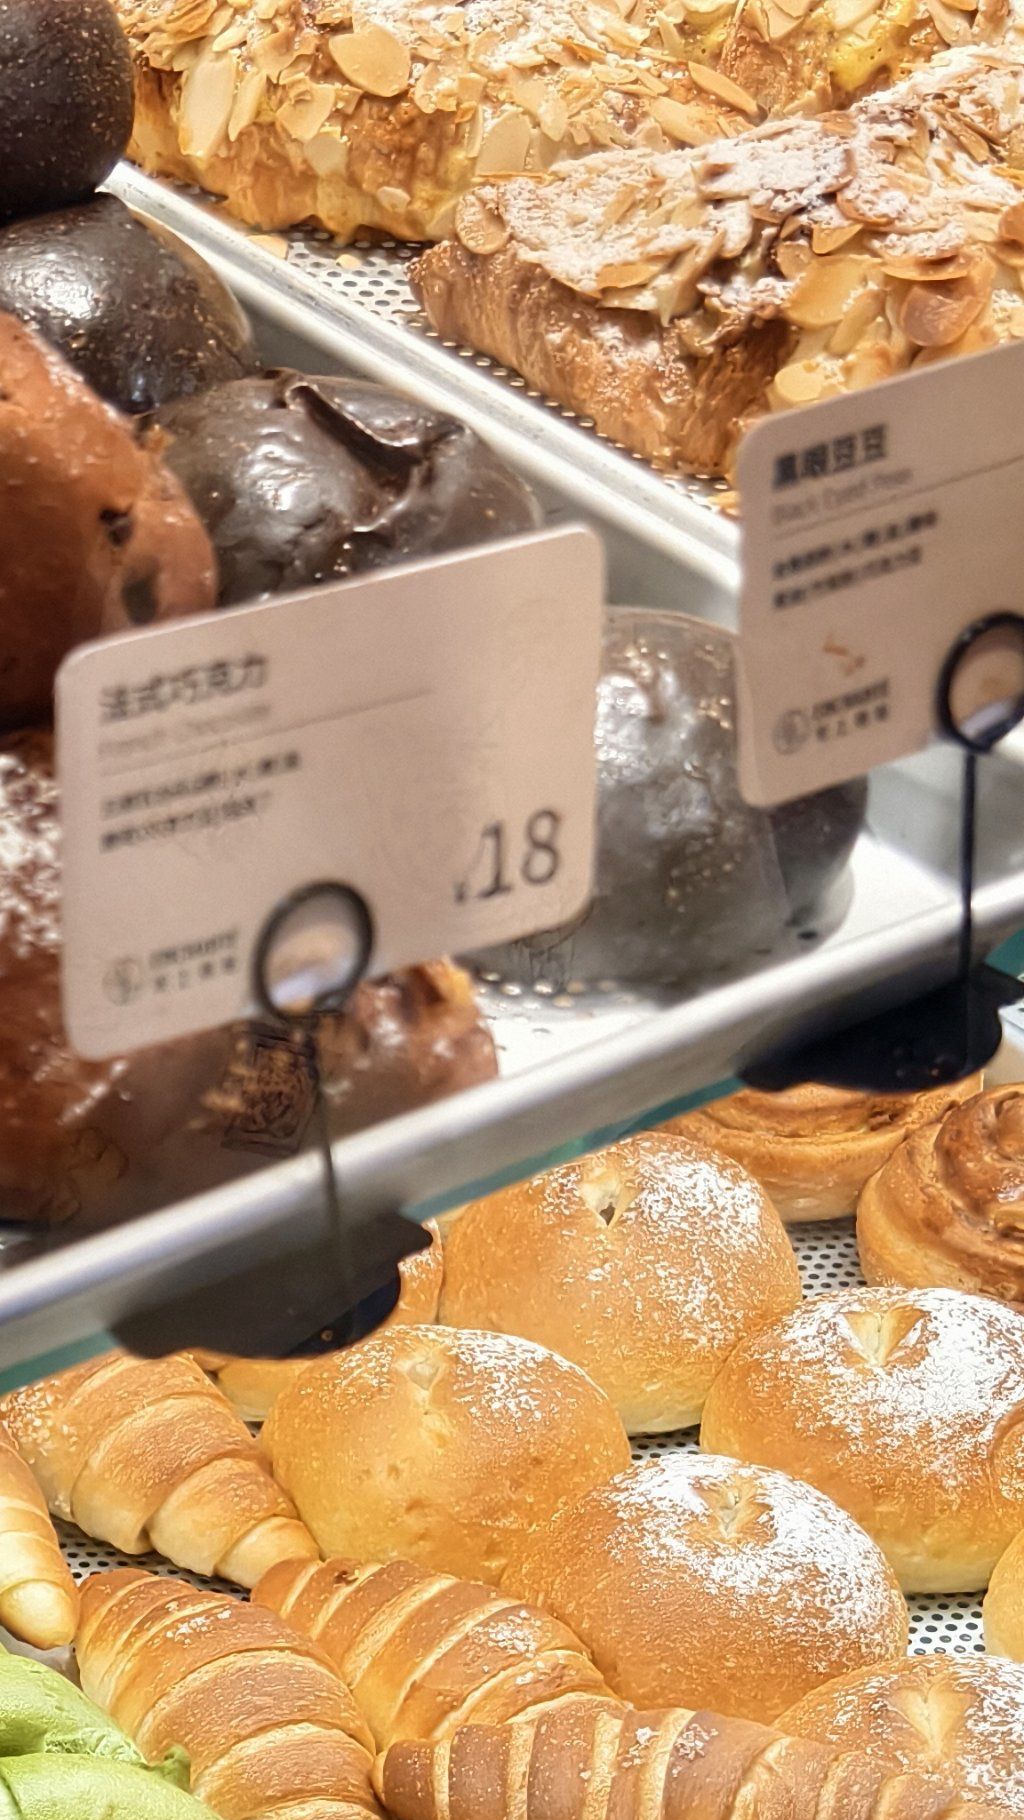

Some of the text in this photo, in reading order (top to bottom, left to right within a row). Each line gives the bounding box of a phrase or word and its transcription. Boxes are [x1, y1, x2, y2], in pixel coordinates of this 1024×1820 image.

[100, 652, 270, 723] 法式巧克力
